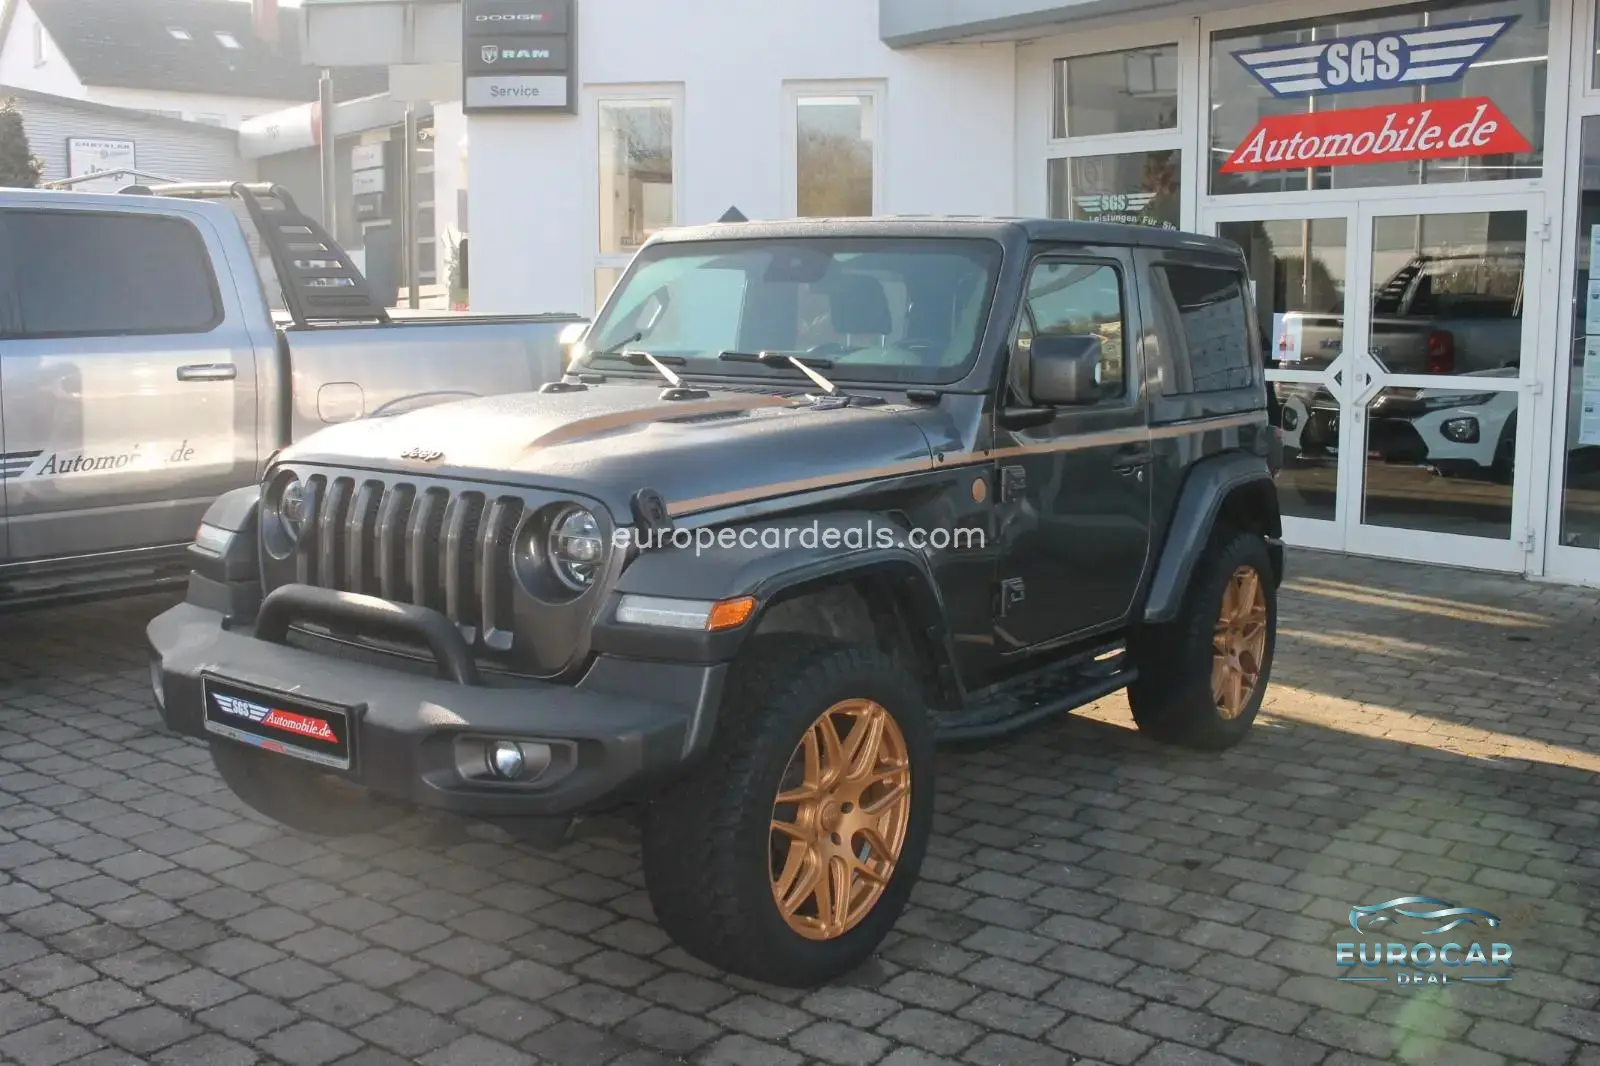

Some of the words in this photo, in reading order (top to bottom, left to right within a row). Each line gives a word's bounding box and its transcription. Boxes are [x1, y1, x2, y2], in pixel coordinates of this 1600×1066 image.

[501, 49, 550, 59] RAM
[1326, 36, 1401, 86] SGS
[489, 84, 540, 98] Service
[1233, 103, 1498, 165] Automobile.de
[1101, 193, 1127, 212] SGS
[1088, 214, 1137, 224] Leistungen
[1142, 216, 1158, 226] Für
[231, 699, 250, 717] SGS
[266, 711, 332, 737] Automobile.de
